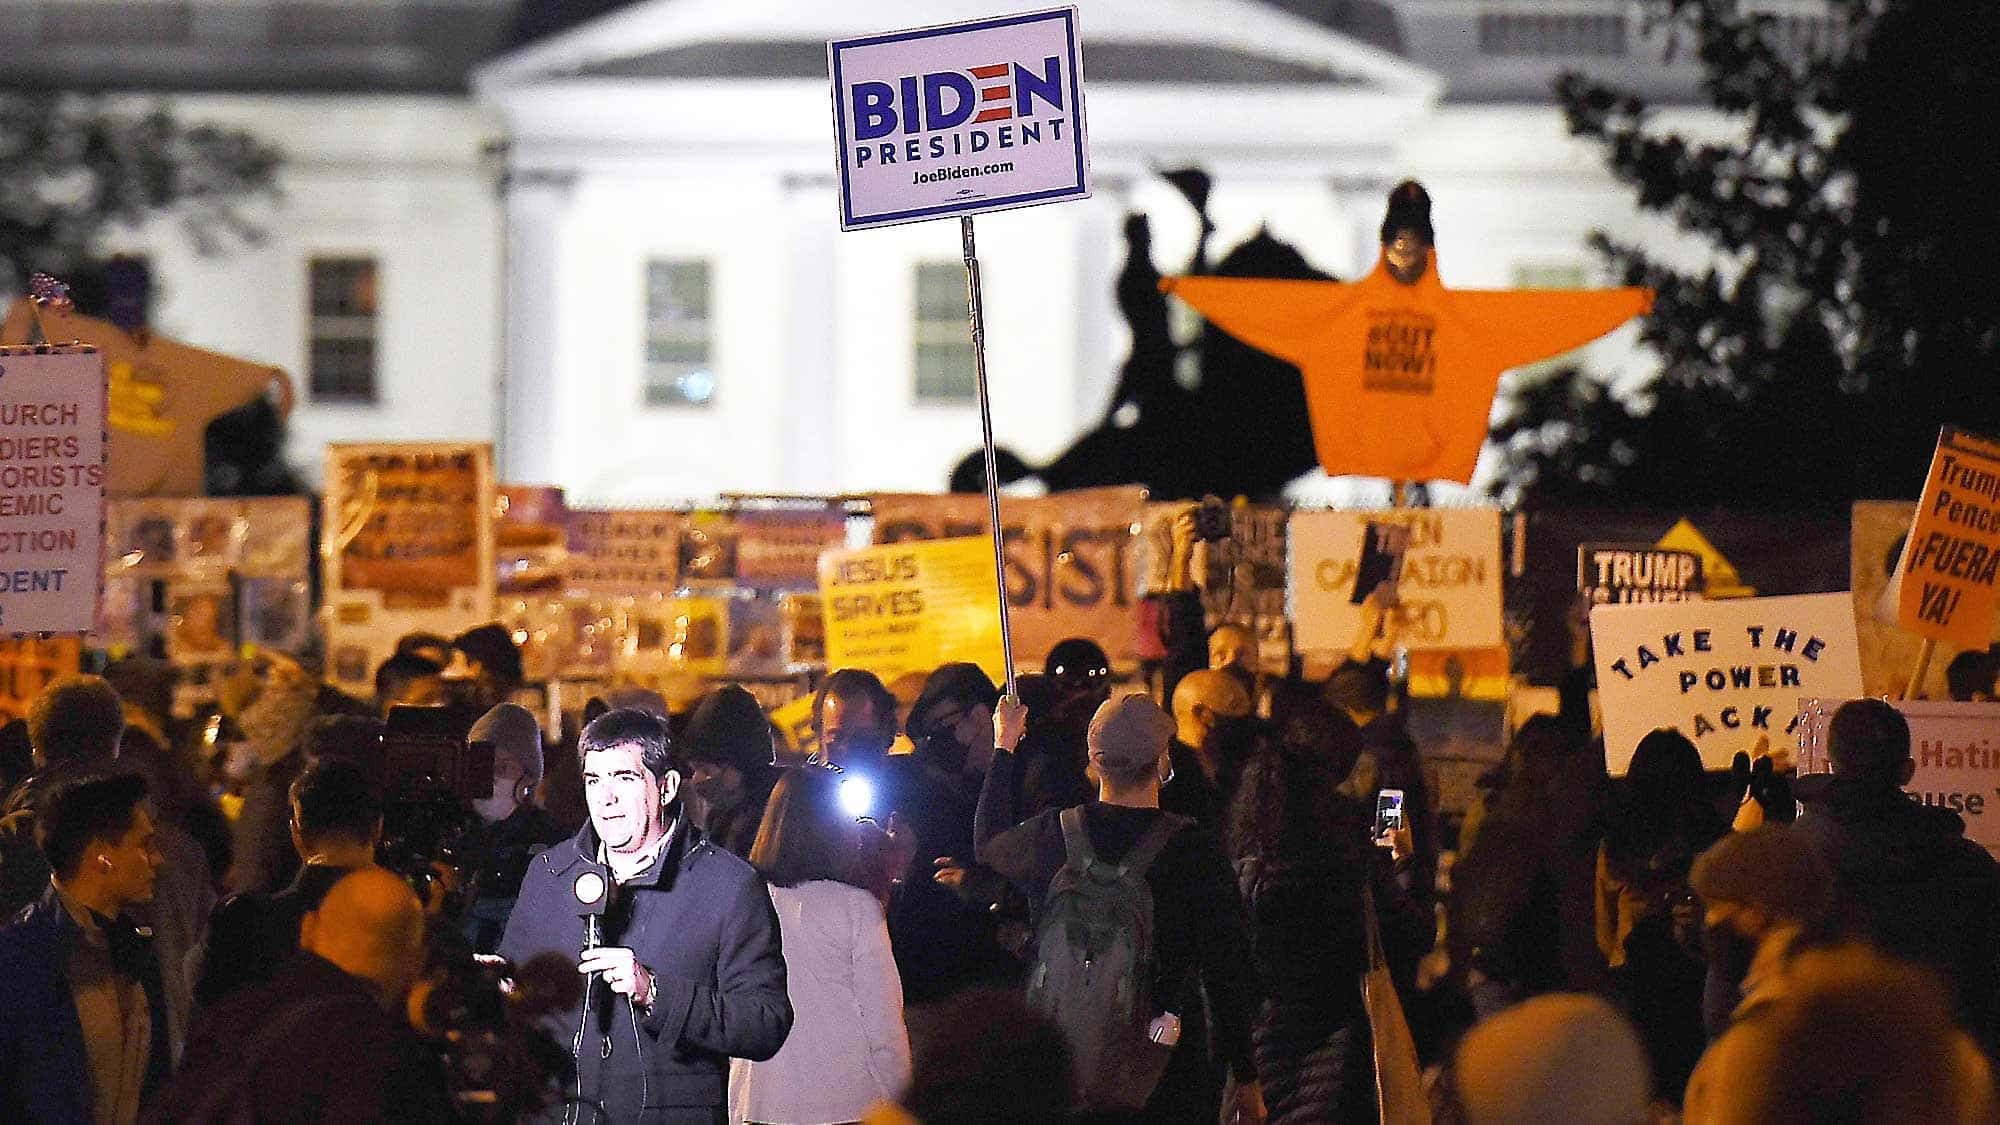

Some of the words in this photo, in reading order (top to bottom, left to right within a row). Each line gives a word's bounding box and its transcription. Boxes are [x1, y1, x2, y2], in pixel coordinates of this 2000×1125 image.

[851, 56, 1064, 141] BIDEN
[856, 118, 1065, 169] PRESIDENT
[913, 161, 1014, 185] JoeBiden.com
[0, 494, 63, 516] EMIC
[1593, 551, 1696, 588] TRUMP
[1918, 581, 1961, 625] YA!
[1611, 629, 1712, 680] TAKE
[1746, 626, 1826, 663] THE
[1680, 664, 1800, 694] POWER
